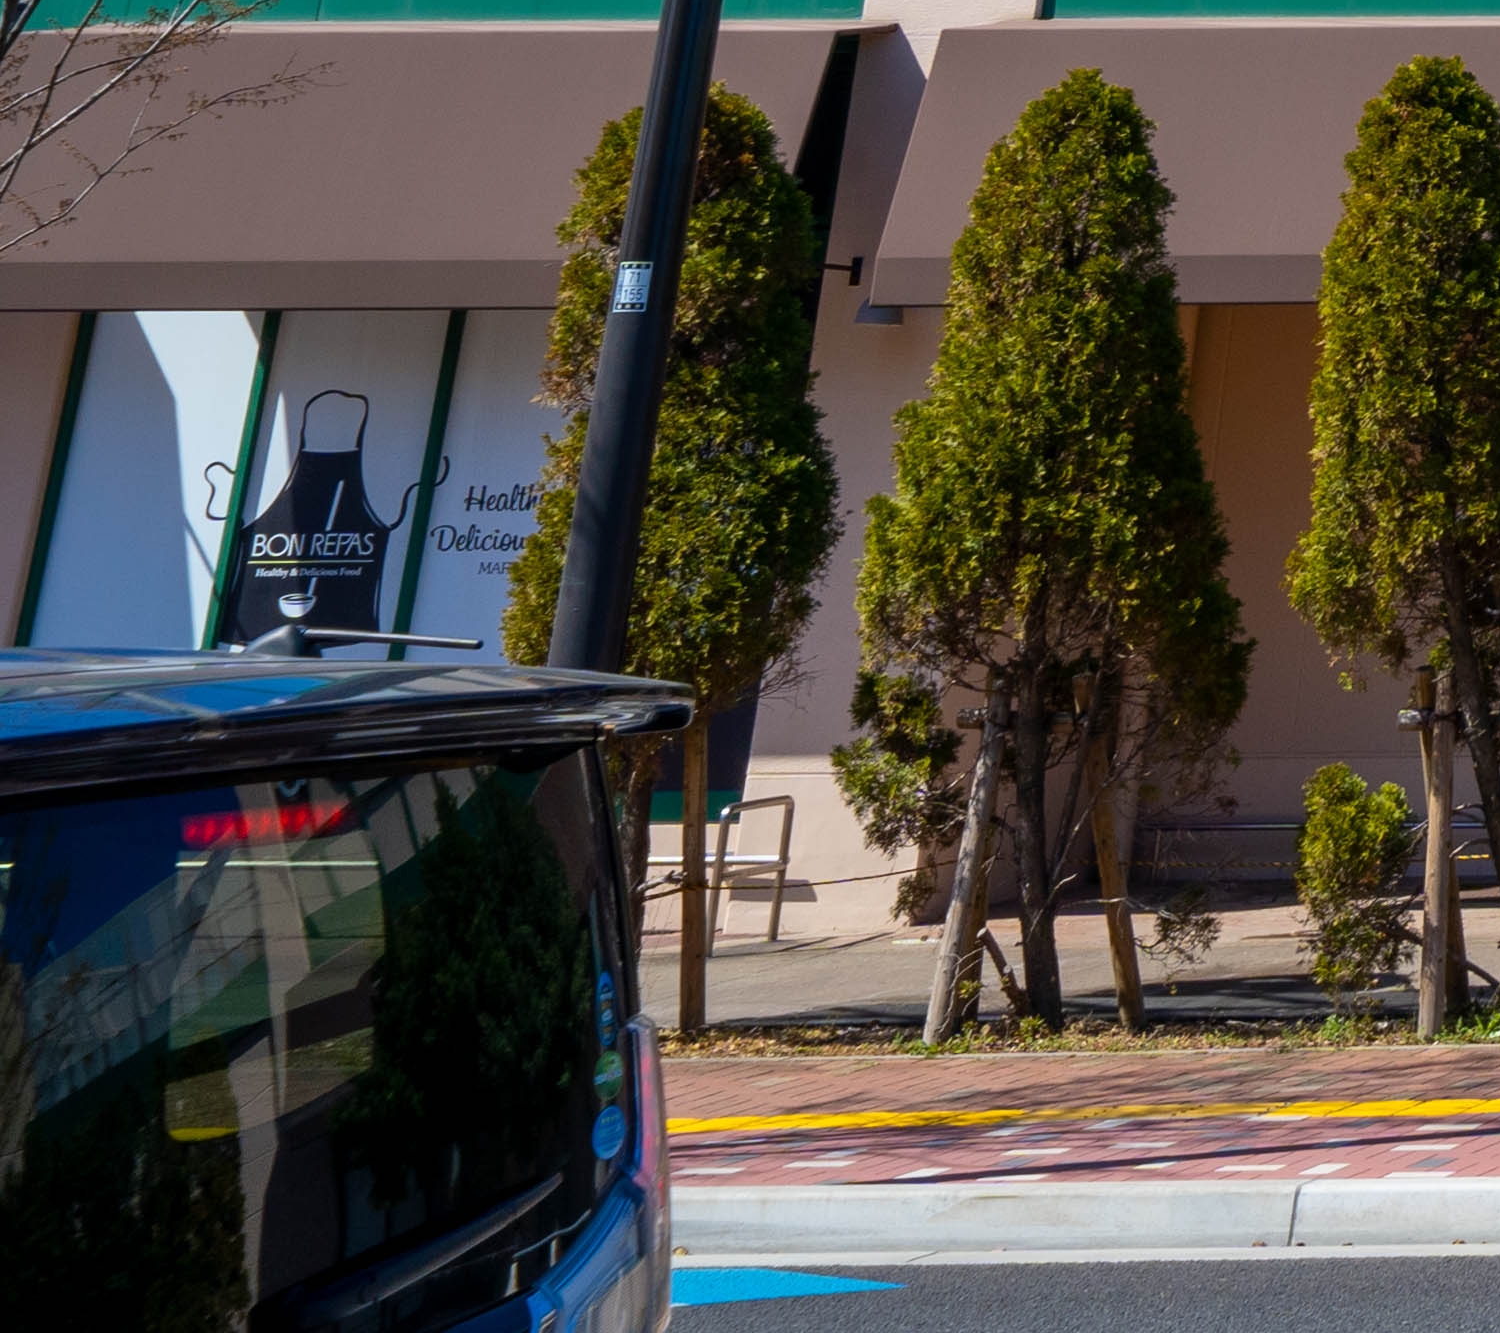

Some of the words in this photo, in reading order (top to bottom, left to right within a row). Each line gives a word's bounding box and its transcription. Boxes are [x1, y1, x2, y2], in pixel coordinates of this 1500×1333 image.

[623, 288, 643, 302] 155
[463, 482, 544, 512] Health
[251, 533, 305, 557] BON
[310, 533, 375, 556] REPAS
[430, 523, 528, 552] Deliciou
[255, 567, 289, 580] Healthy
[289, 567, 298, 577] &
[299, 567, 338, 577] Delicious
[340, 566, 362, 577] Food
